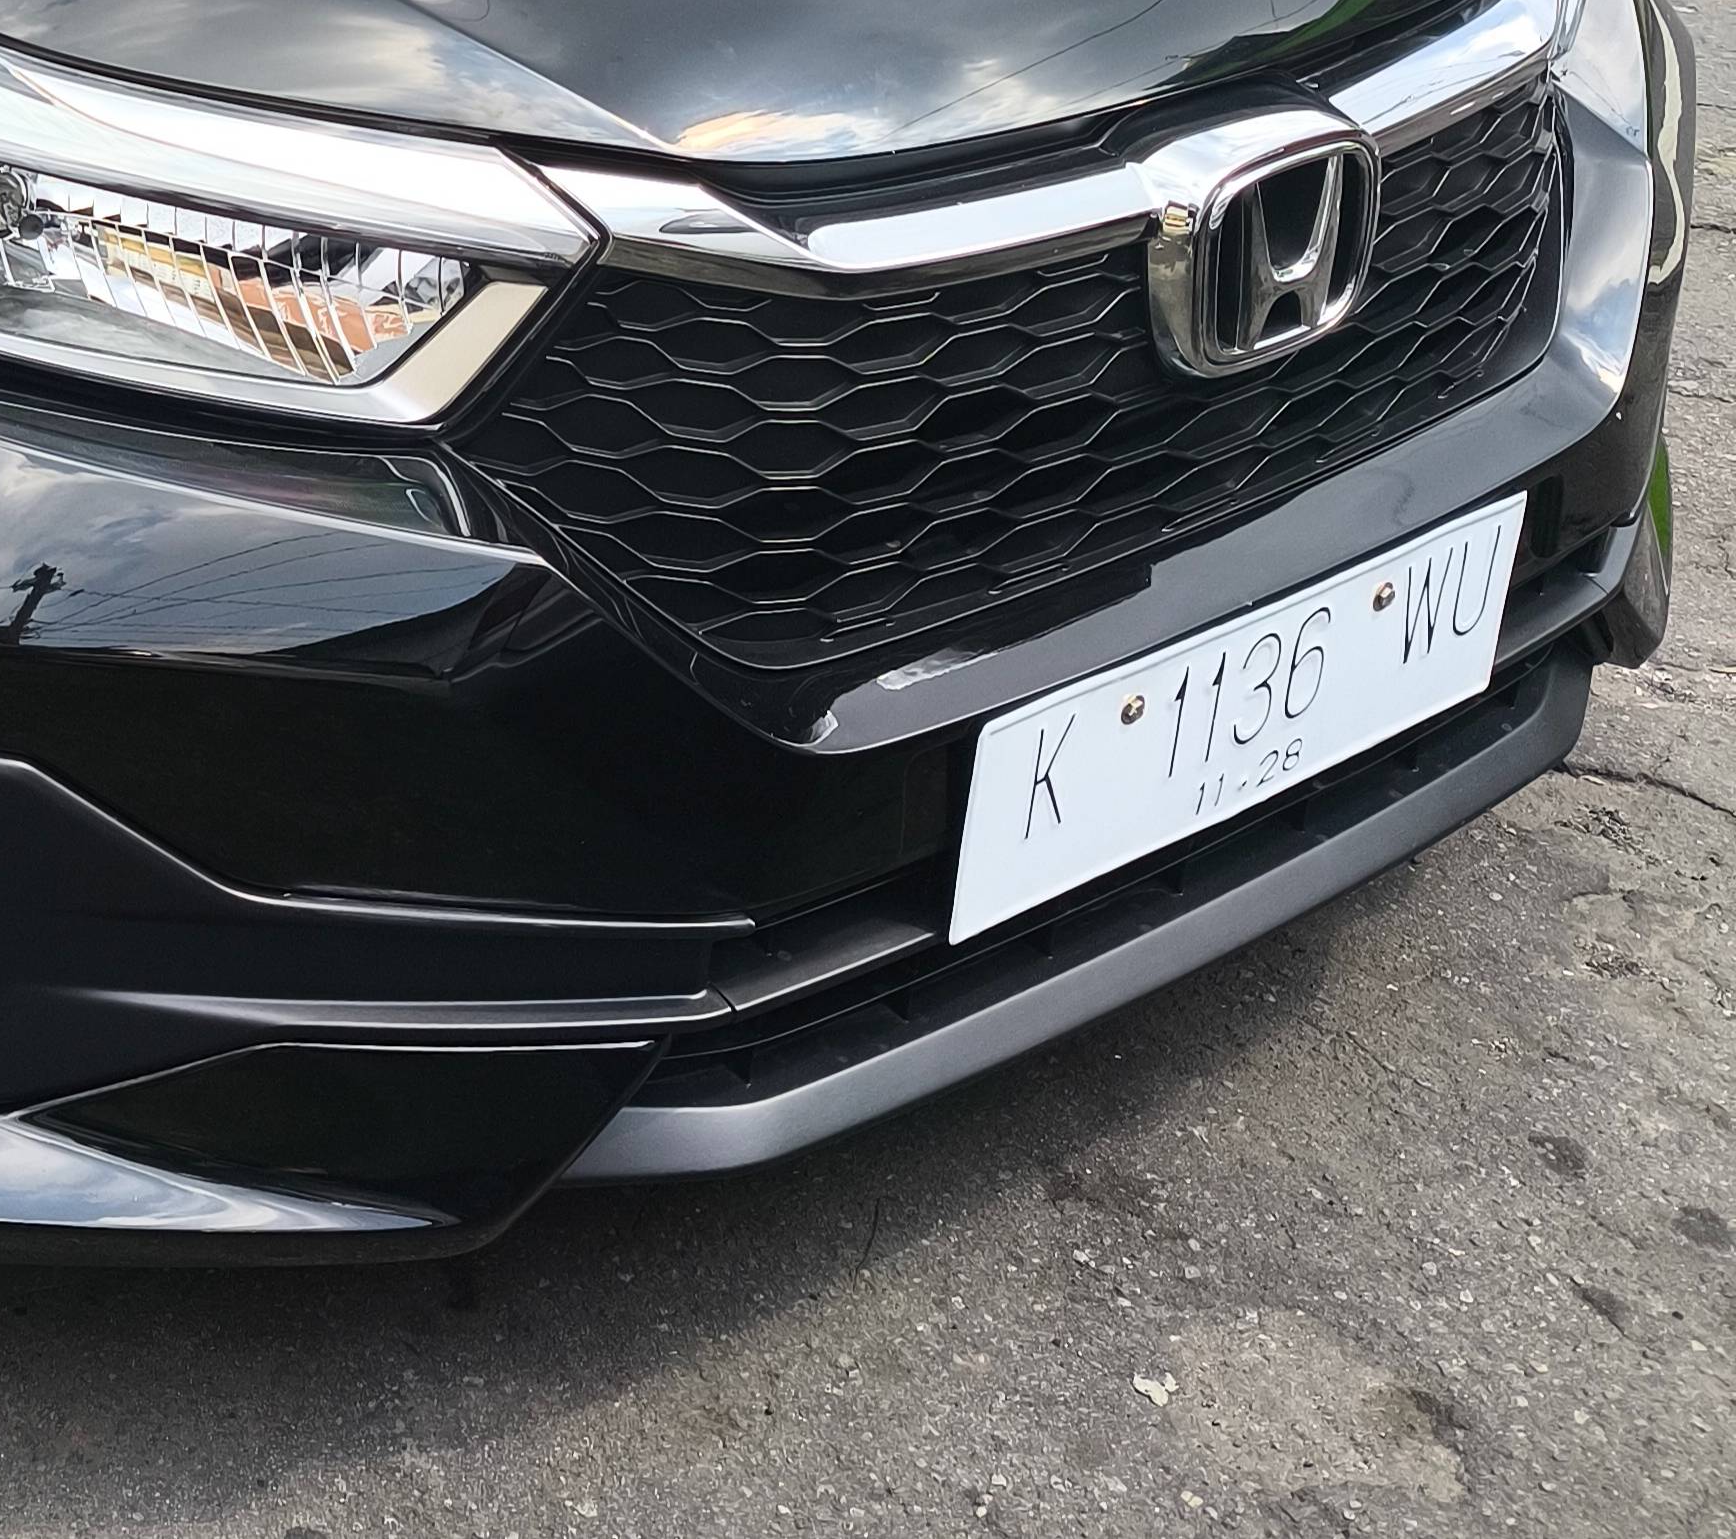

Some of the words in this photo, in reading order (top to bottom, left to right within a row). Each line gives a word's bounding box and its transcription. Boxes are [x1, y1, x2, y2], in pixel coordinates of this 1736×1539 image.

[1025, 713, 1076, 839] K
[1168, 608, 1331, 777] 1136
[1403, 525, 1501, 664] WU
